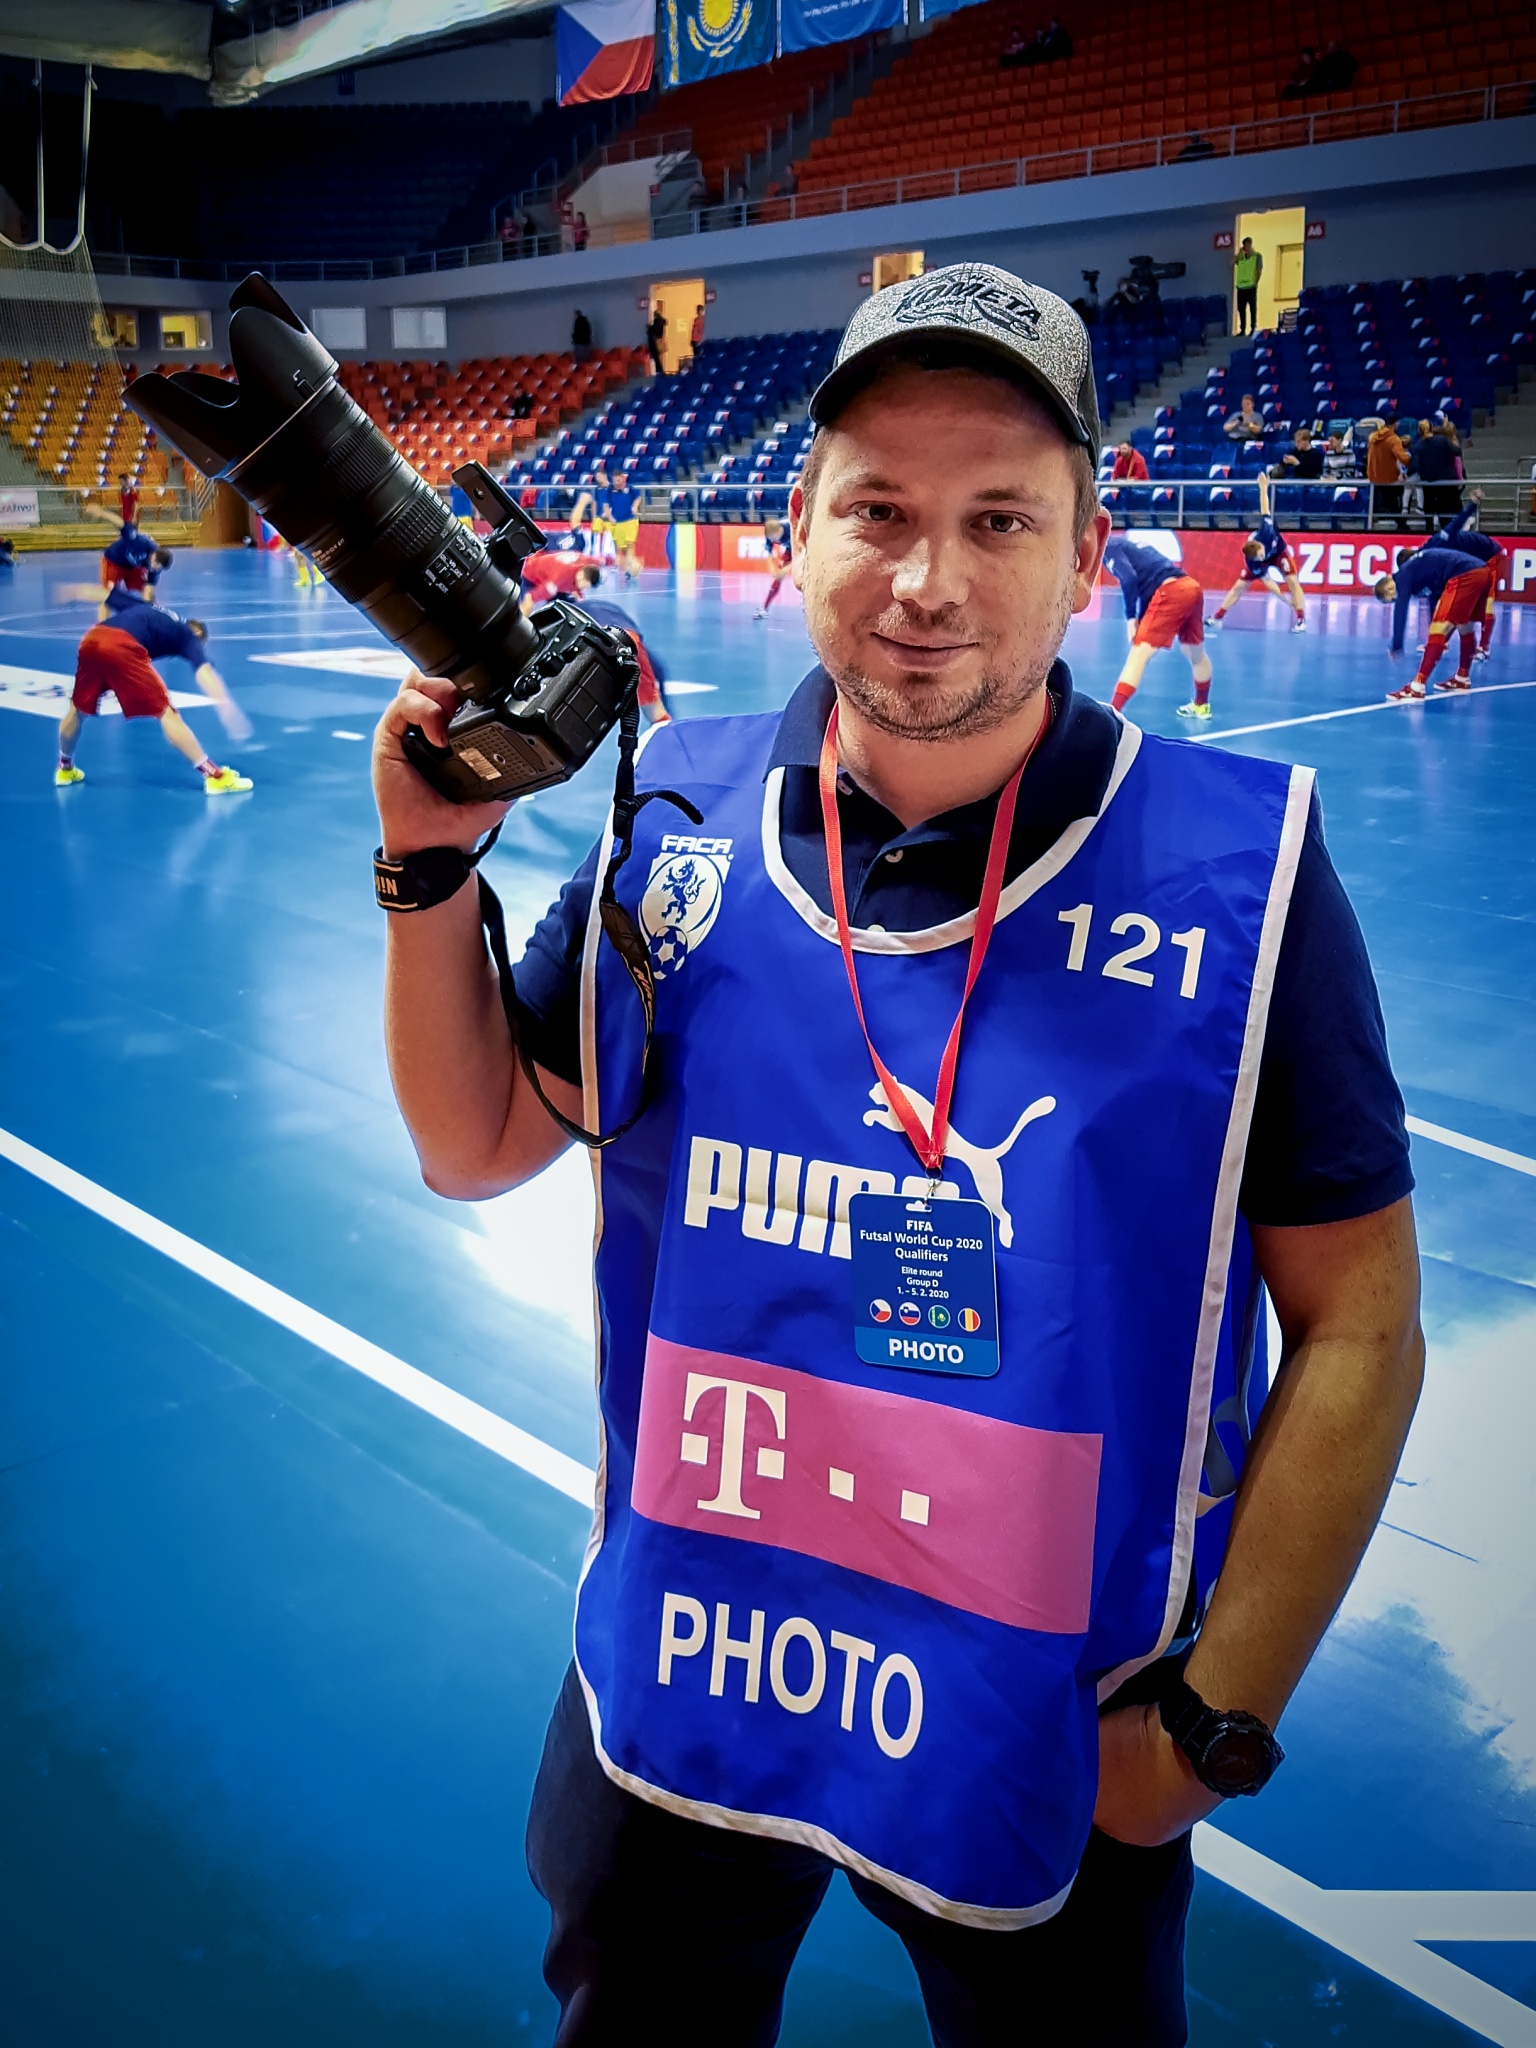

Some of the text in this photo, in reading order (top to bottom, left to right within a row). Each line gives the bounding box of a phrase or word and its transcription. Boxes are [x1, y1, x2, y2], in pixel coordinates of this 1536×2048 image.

[1057, 903, 1206, 1000] 121
[906, 1219, 934, 1232] FIFA
[860, 1229, 983, 1250] Futsal World Cup 2020
[894, 1247, 949, 1262] Qualifiers
[901, 1266, 943, 1278] Elite round
[906, 1277, 939, 1288] Group D
[896, 1286, 904, 1295] 1.
[911, 1287, 919, 1296] 5.
[920, 1288, 928, 1297] 2.
[928, 1289, 950, 1299] 2020
[888, 1338, 965, 1364] PHOTO
[657, 1591, 924, 1759] PHOTO
